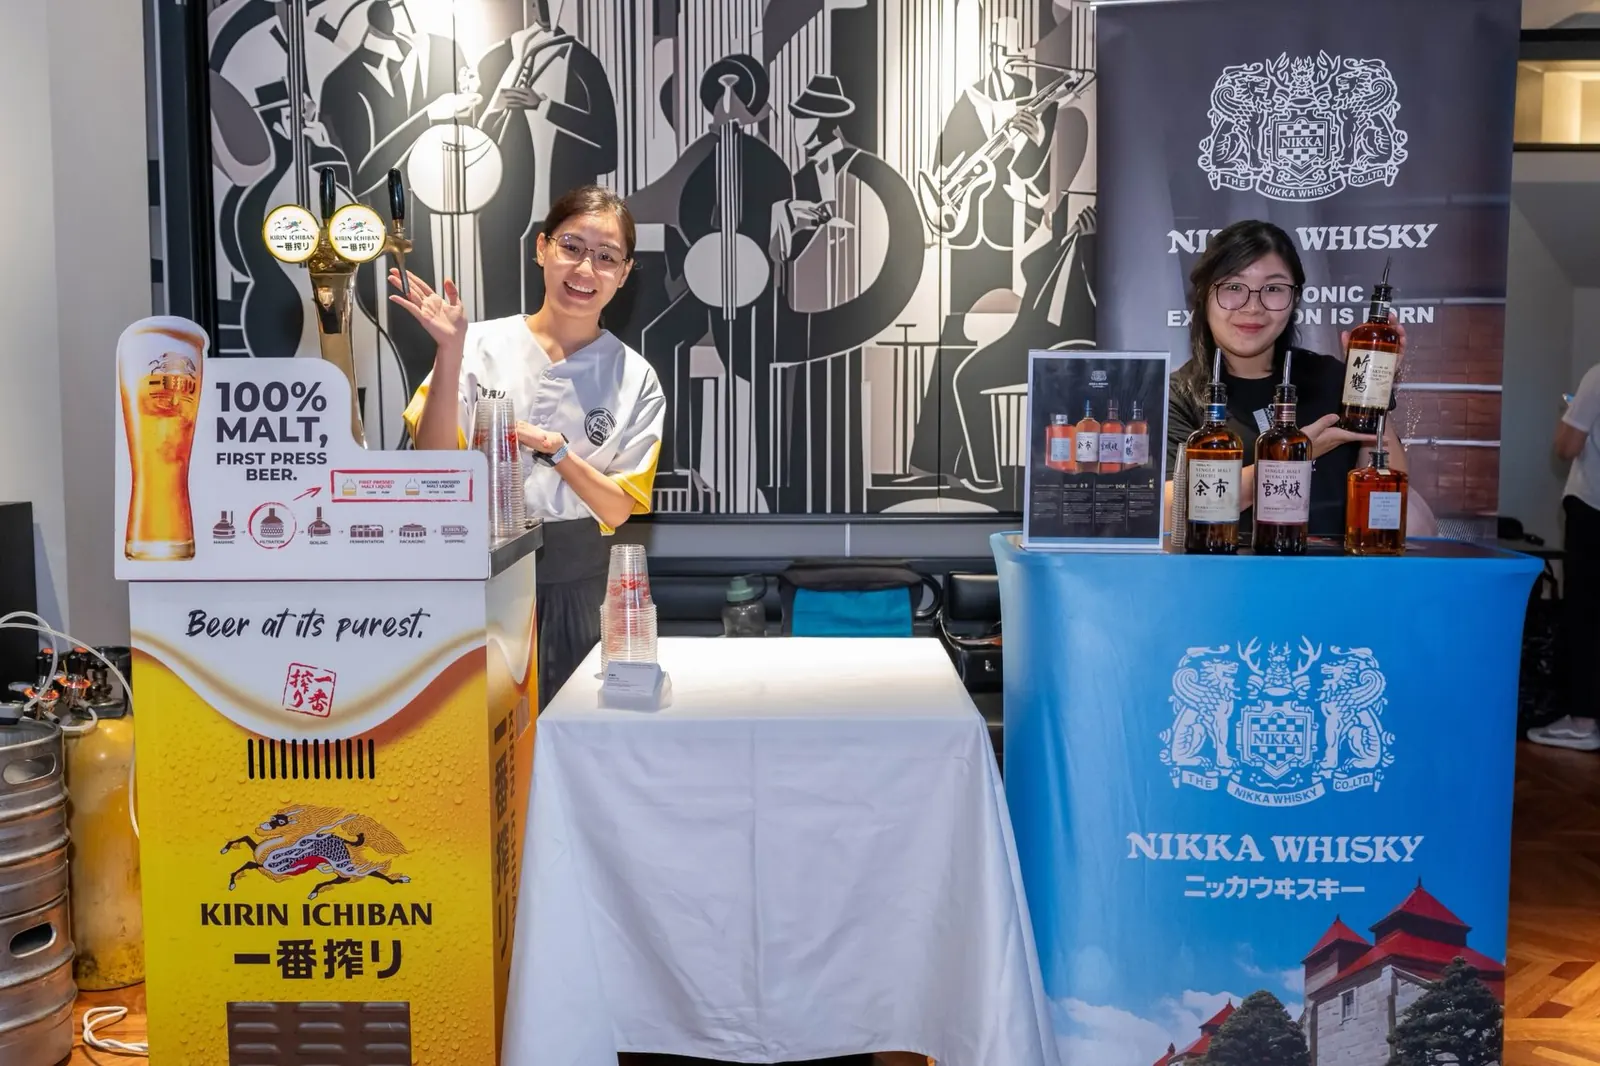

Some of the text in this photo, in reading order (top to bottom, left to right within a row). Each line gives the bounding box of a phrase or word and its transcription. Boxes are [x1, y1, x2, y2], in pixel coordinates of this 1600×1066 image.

[1281, 136, 1322, 148] NIKKA
[1224, 176, 1246, 188] THE
[1264, 184, 1296, 198] NIKKA
[1298, 182, 1336, 198] WHISKY
[276, 242, 310, 251] 一番搾り
[342, 243, 374, 252] 一番搾り
[1296, 224, 1438, 250] WHISKY
[1302, 286, 1364, 303] ONIC
[1331, 308, 1354, 324] IS
[216, 382, 327, 412] 100%
[216, 416, 328, 448] MALT,
[216, 452, 328, 465] FIRST PRESS
[246, 468, 298, 481] BEER.
[1194, 478, 1229, 498] 余市
[186, 608, 430, 642] Beer at its purest.
[1253, 732, 1301, 745] NIKKA
[1188, 774, 1212, 788] THE
[1234, 787, 1270, 804] NIKKA
[1274, 787, 1318, 804] WHISKY
[1126, 832, 1424, 863] NIKKA WHISKY
[1184, 875, 1366, 901] ニッカウヰスキー
[200, 903, 432, 926] KIRIN ICHIBAN
[234, 938, 402, 980] 一番搾り
